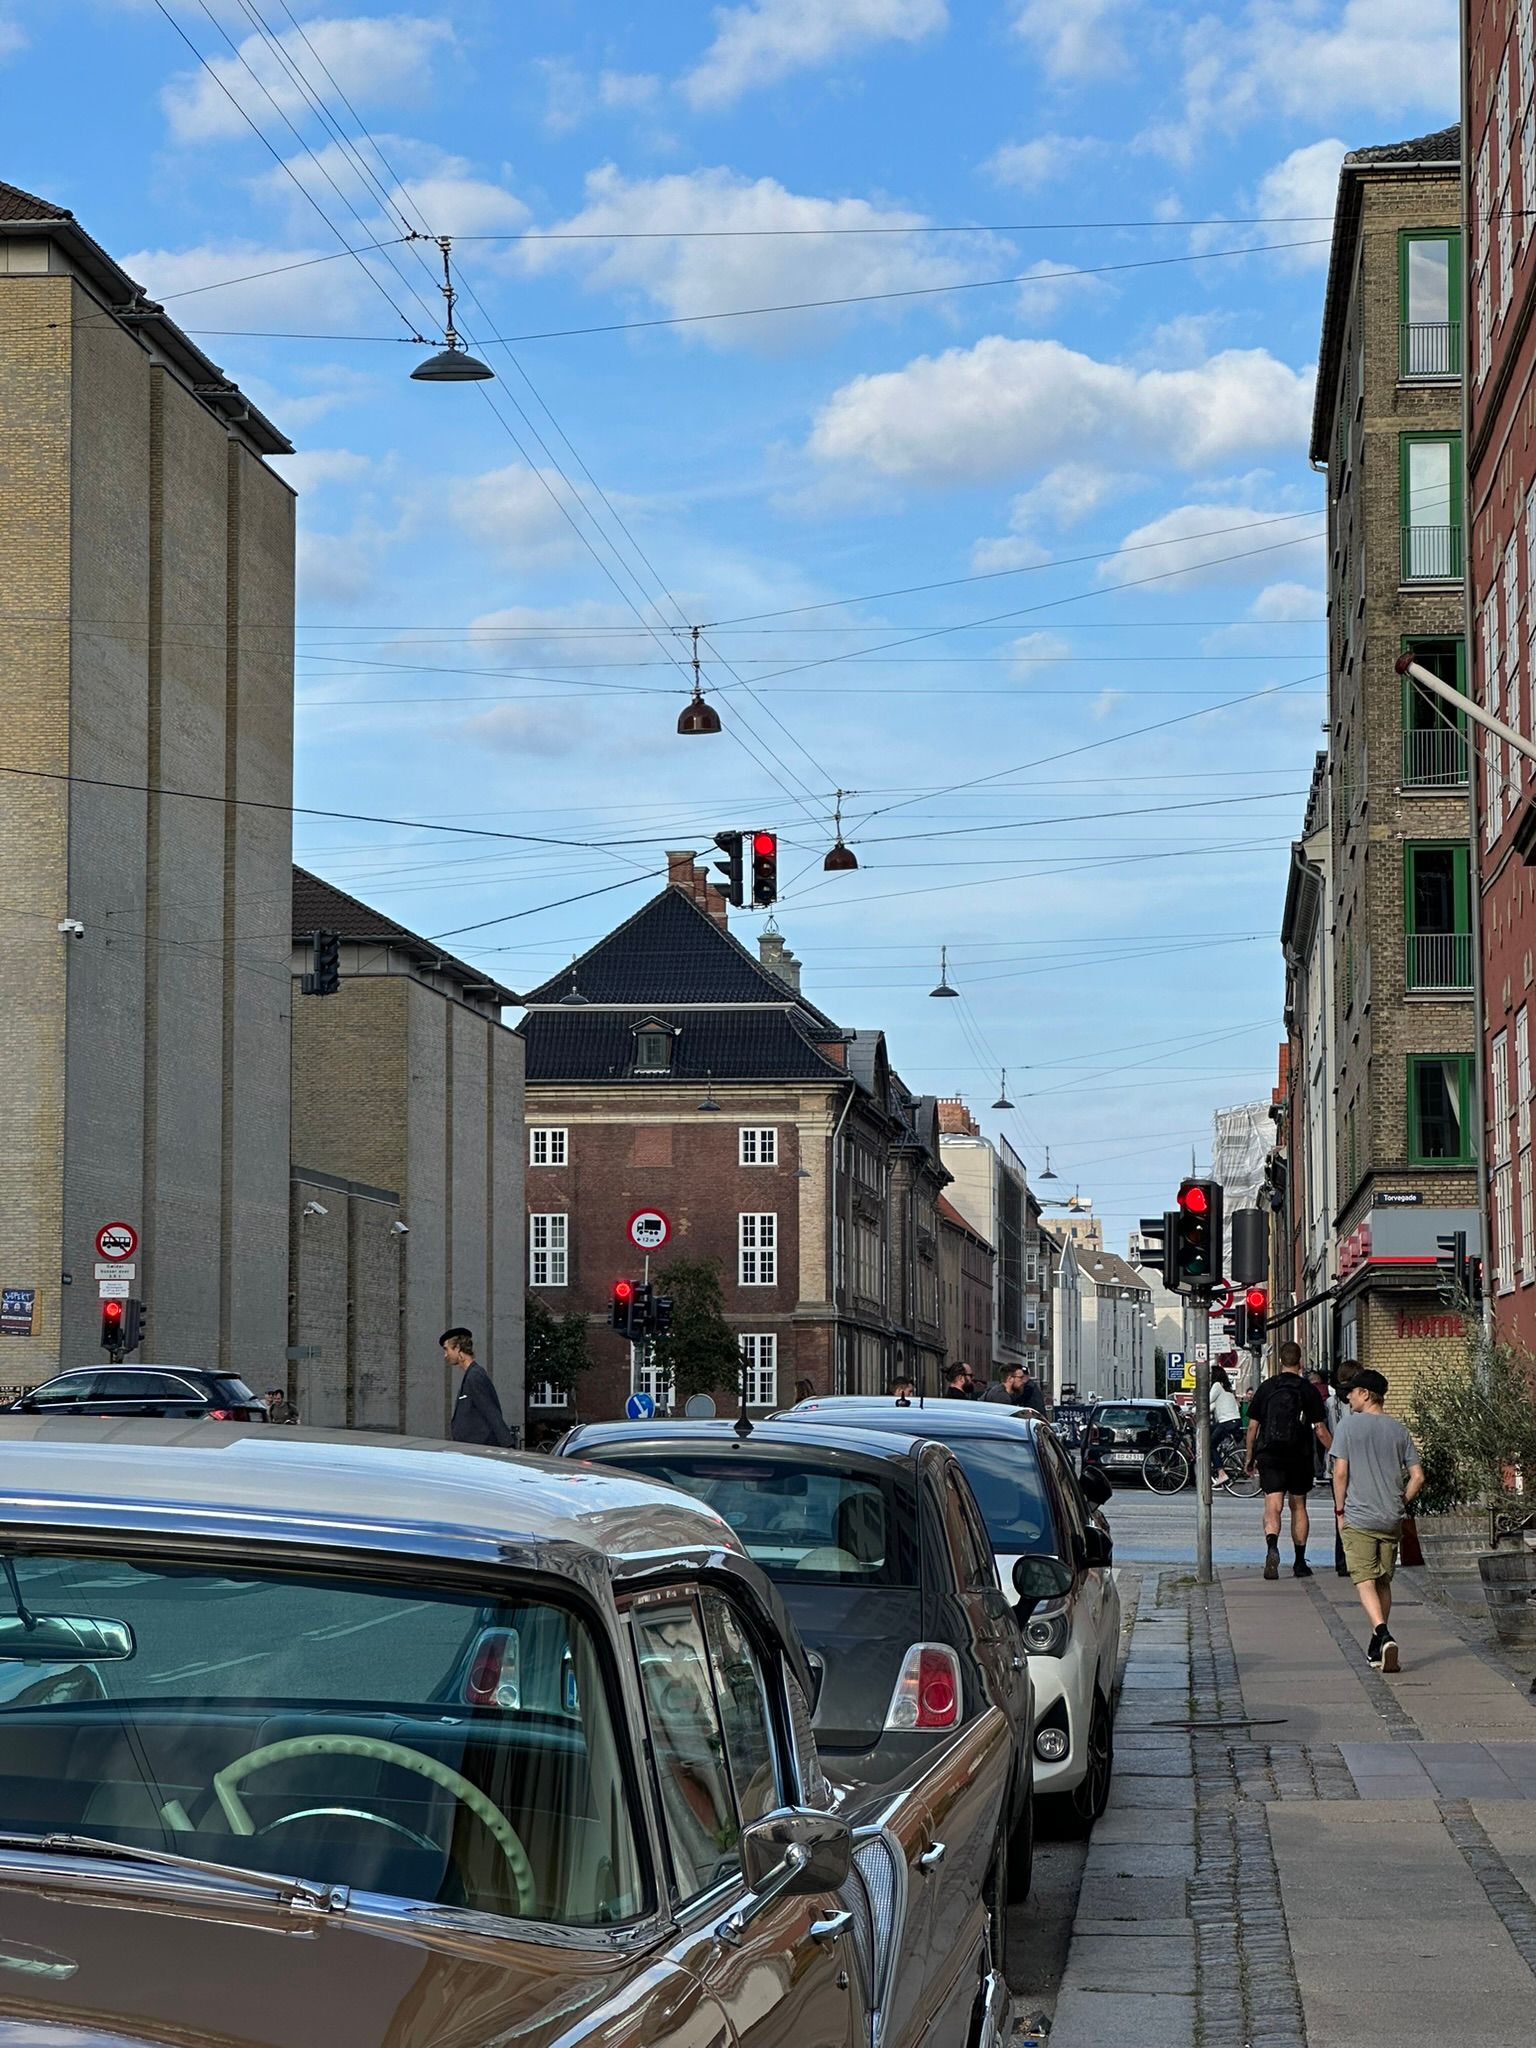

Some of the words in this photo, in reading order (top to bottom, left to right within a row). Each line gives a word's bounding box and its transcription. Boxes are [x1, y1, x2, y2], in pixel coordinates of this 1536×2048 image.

[1383, 1194, 1417, 1203] Torvegade
[1397, 1308, 1467, 1339] home
[1171, 1354, 1182, 1368] P
